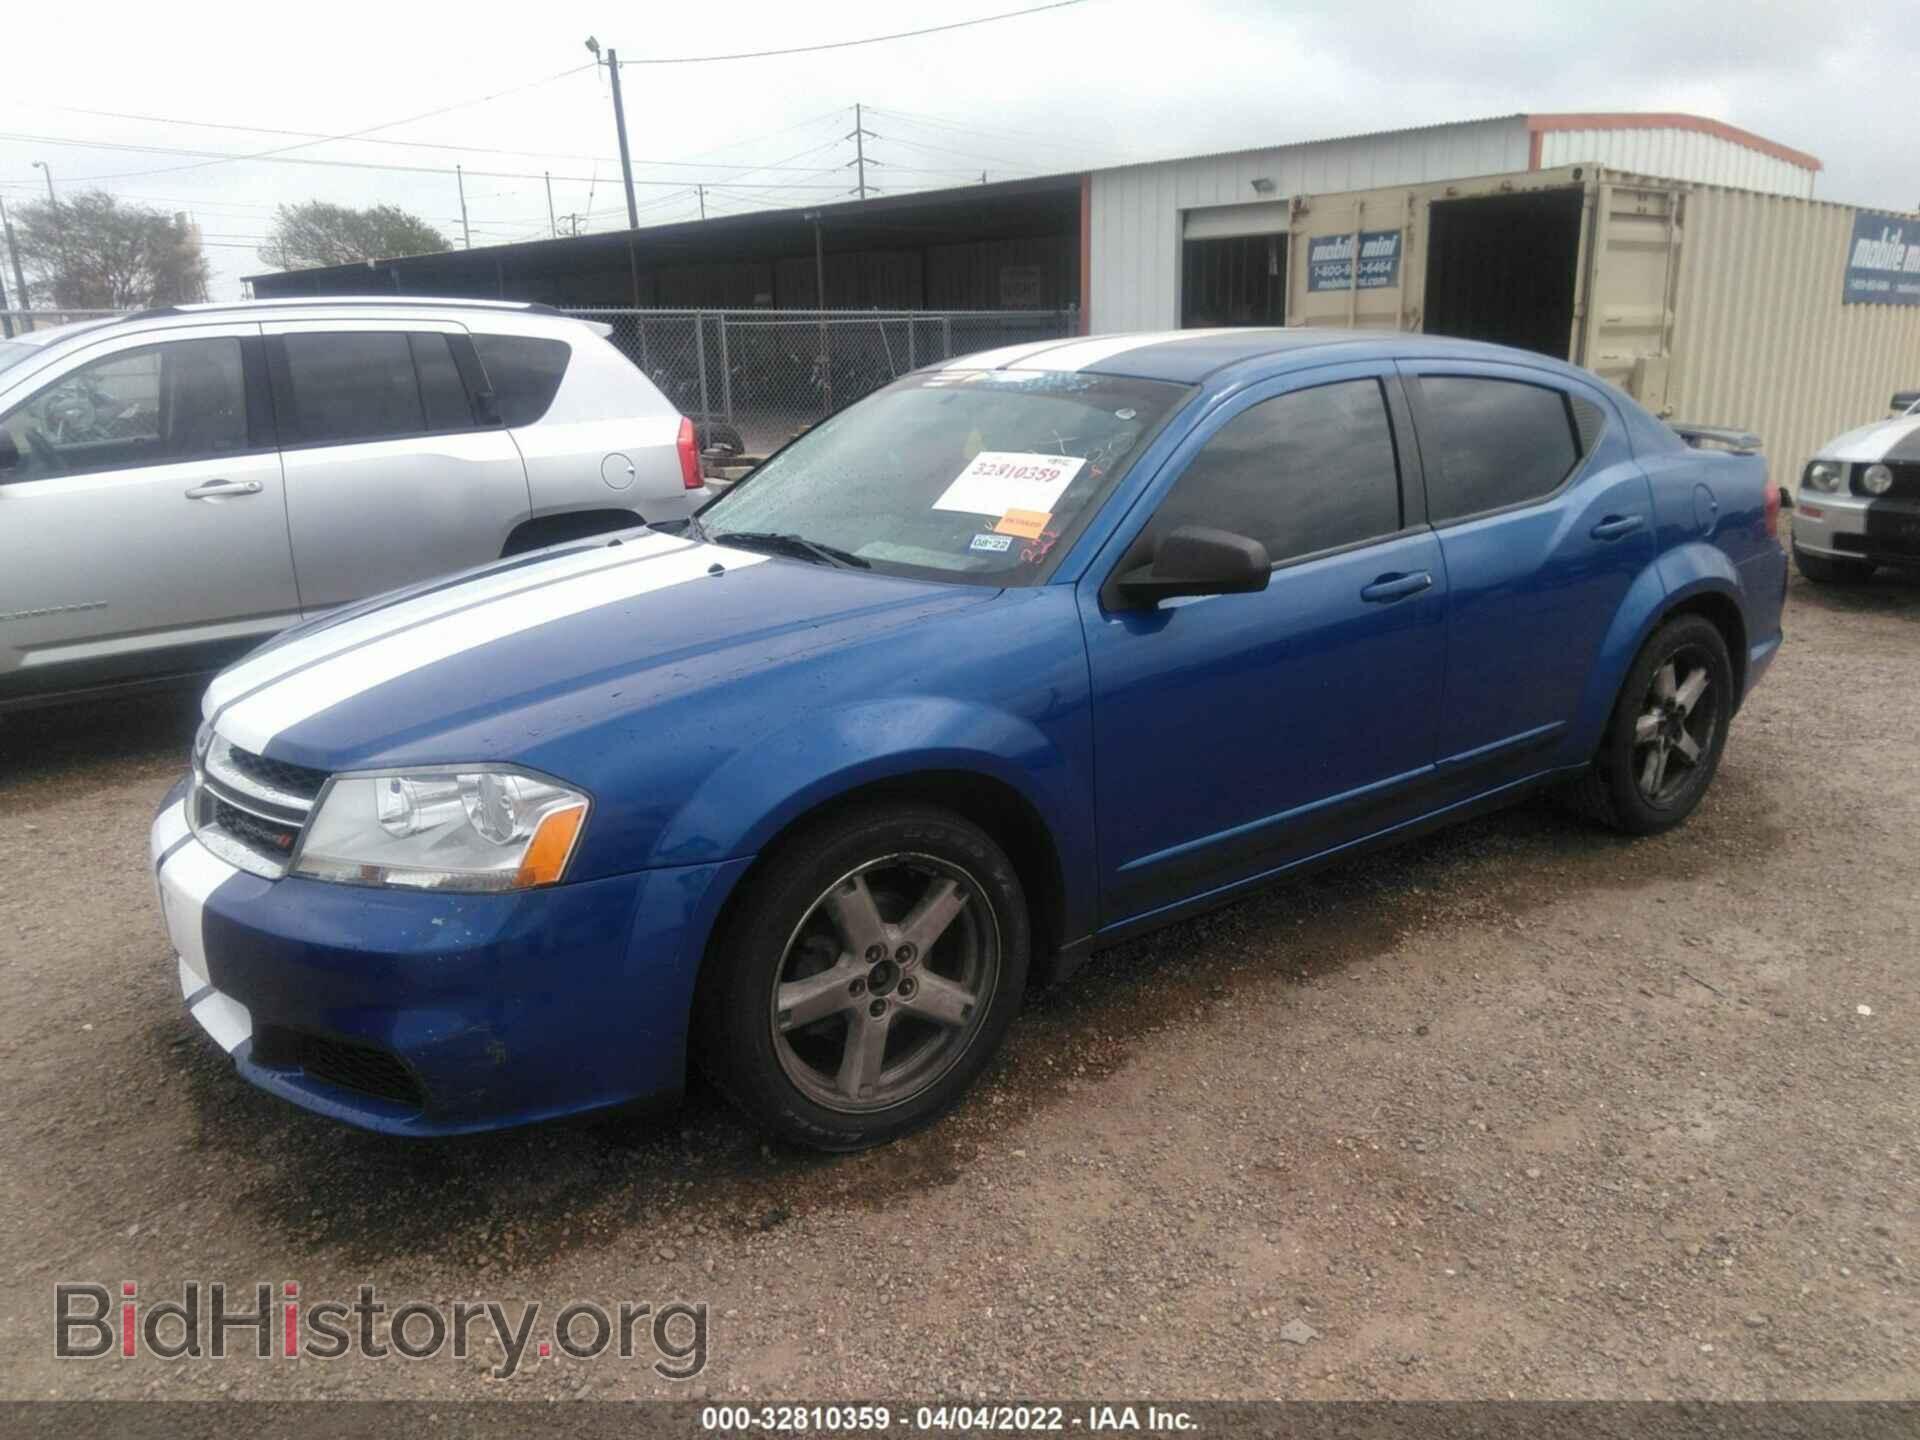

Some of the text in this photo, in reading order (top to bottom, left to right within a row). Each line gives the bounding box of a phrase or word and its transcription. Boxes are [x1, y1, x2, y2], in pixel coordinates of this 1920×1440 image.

[1312, 235, 1398, 261] mobil mini
[1851, 226, 1906, 272] mobile
[972, 462, 1061, 482] 32810359
